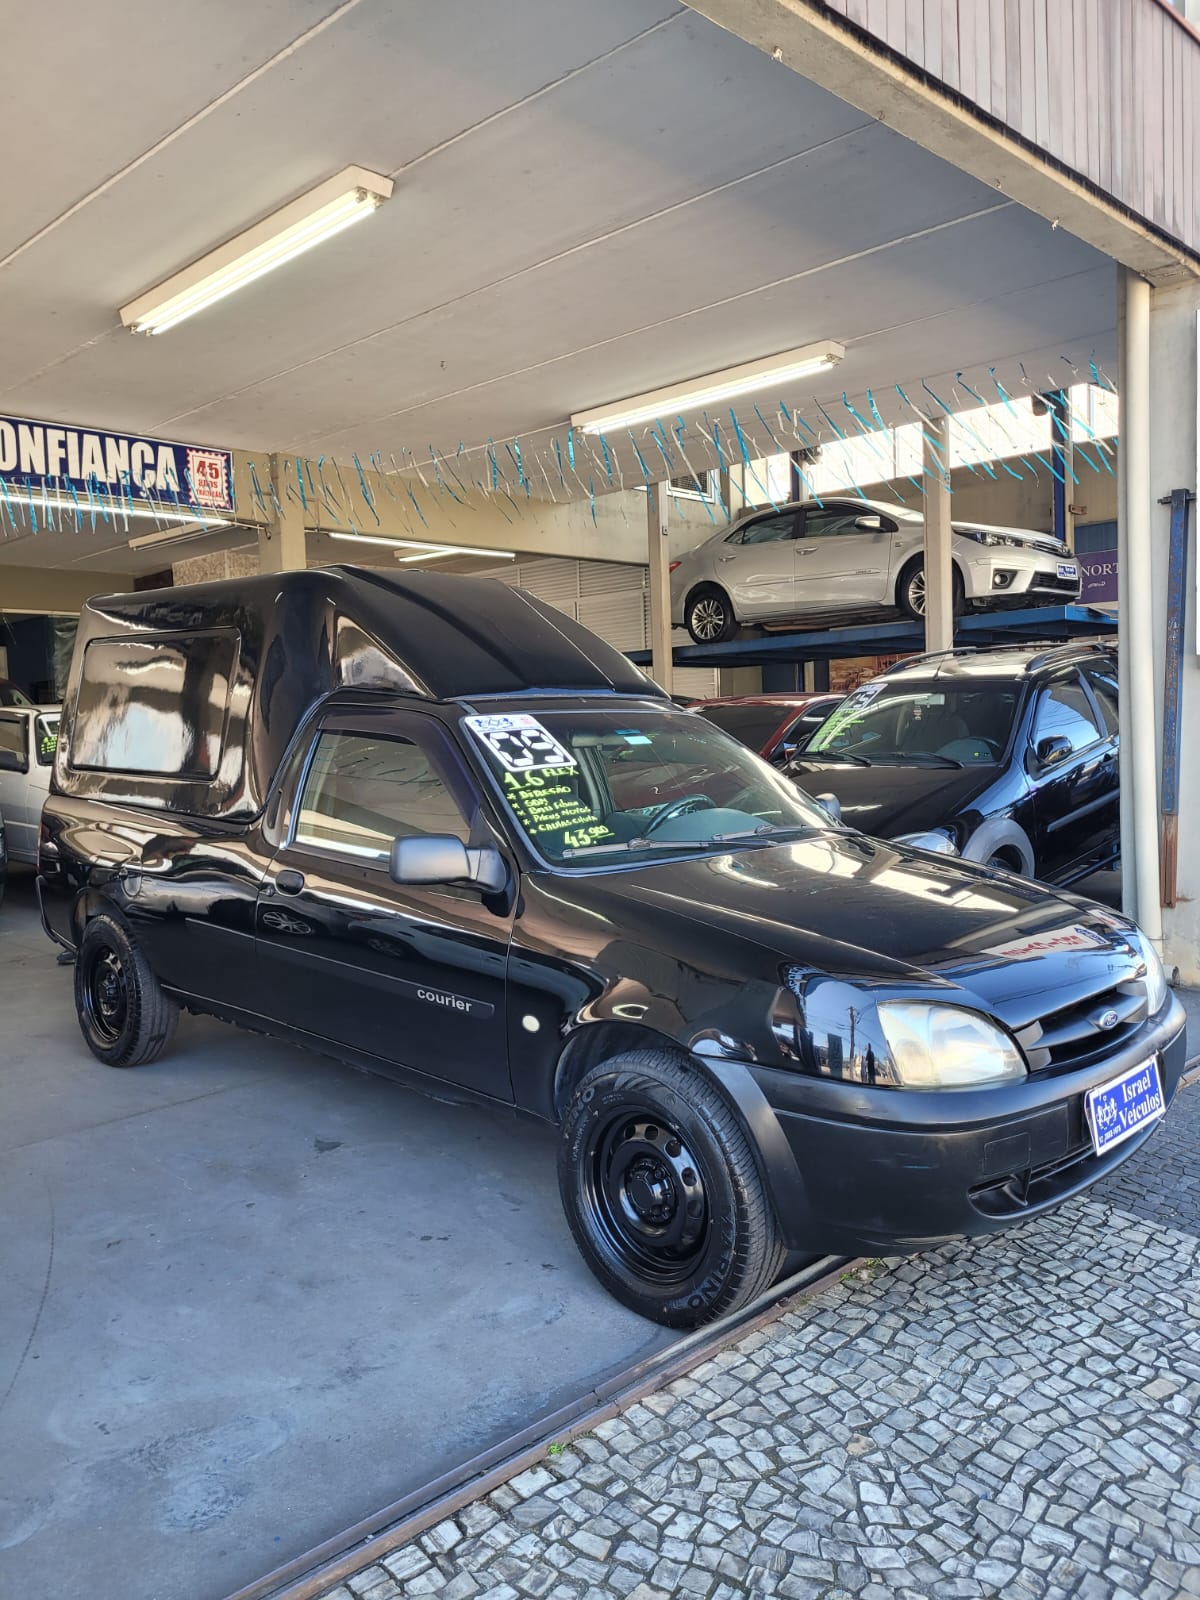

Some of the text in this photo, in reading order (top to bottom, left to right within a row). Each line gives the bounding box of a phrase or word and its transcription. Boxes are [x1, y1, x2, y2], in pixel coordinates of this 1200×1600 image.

[197, 461, 219, 479] 45
[490, 729, 564, 766] 09
[504, 770, 544, 790] 1.6
[417, 989, 472, 1012] courier
[1121, 1069, 1152, 1103] Israel
[1119, 1094, 1160, 1129] Veículos
